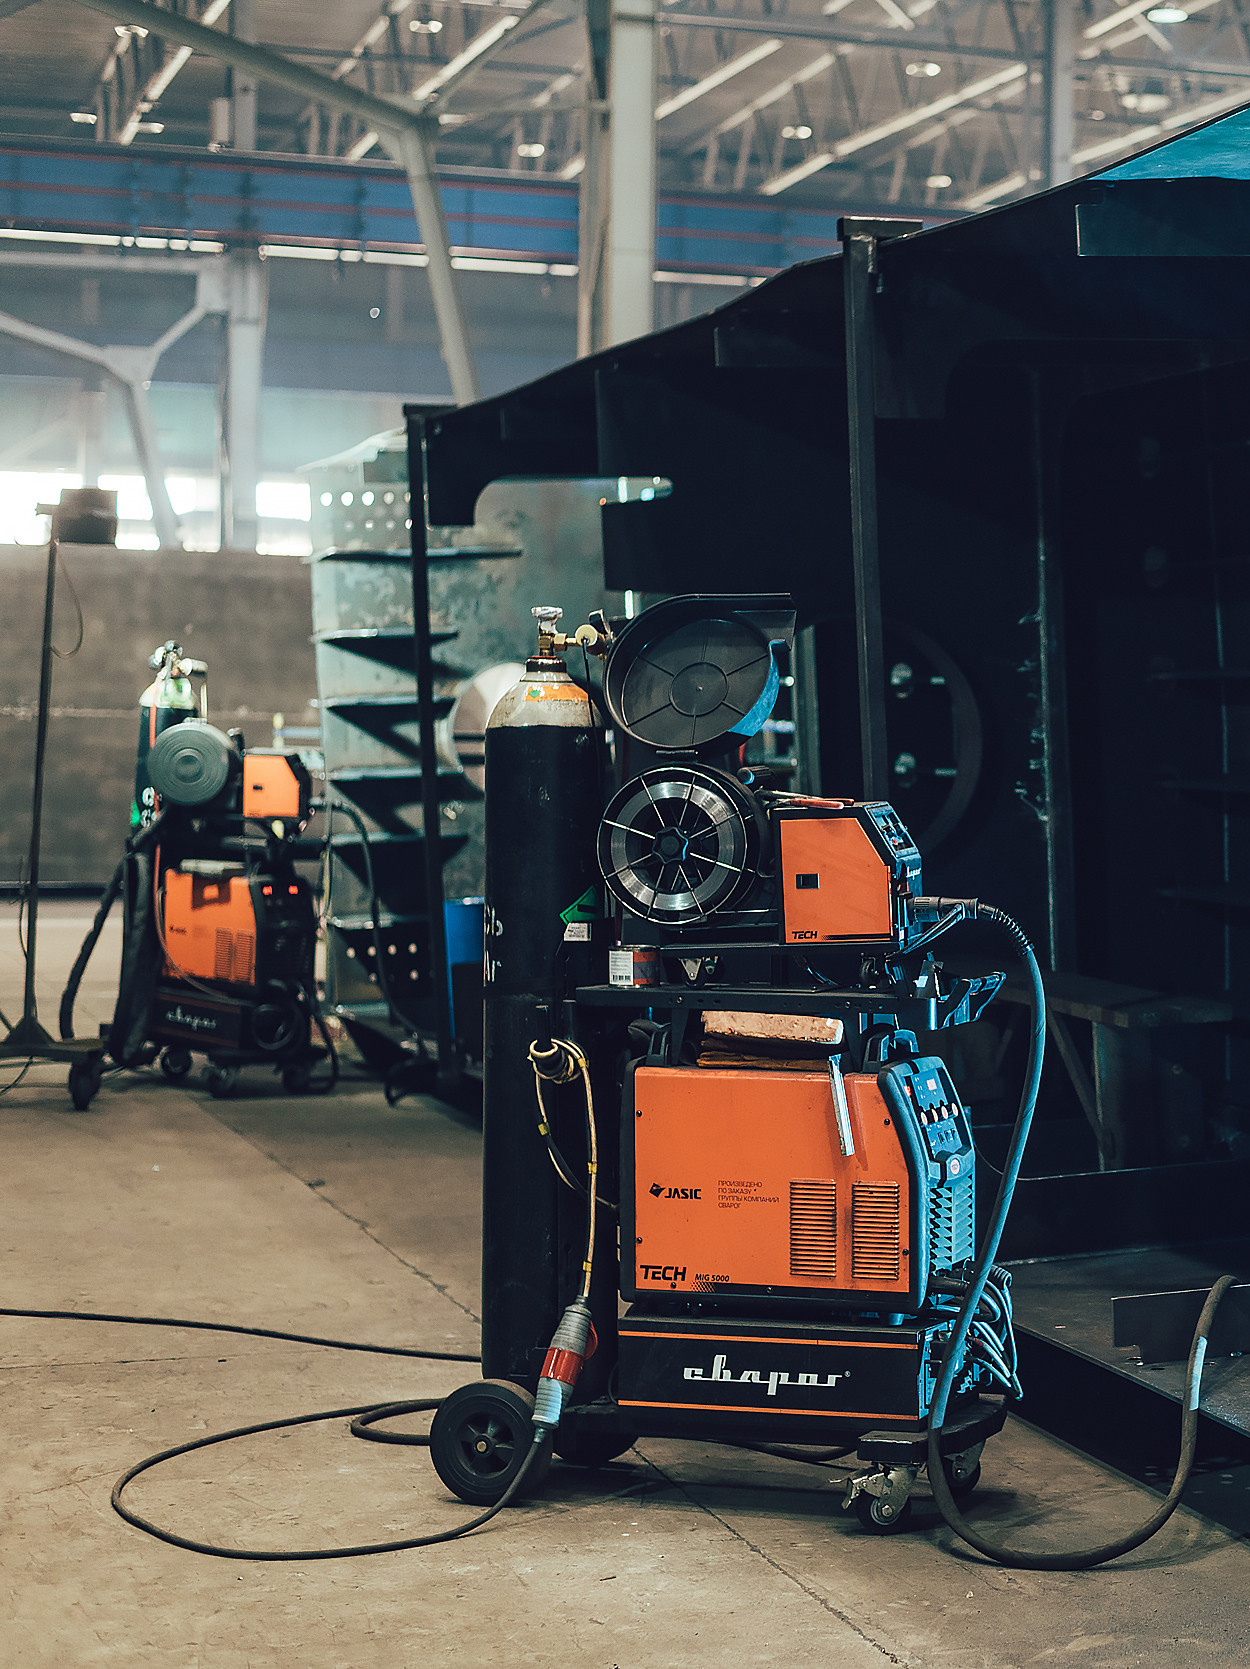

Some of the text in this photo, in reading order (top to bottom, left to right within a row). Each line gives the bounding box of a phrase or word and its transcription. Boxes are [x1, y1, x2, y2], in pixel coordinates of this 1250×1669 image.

[791, 930, 818, 940] TECH
[717, 1180, 763, 1188] ПРОИЗВЕДЕНО
[664, 1187, 702, 1200] JASIC
[728, 1187, 752, 1195] ЗАКАЗУ
[639, 1264, 687, 1281] TECH
[694, 1273, 710, 1282] MIG
